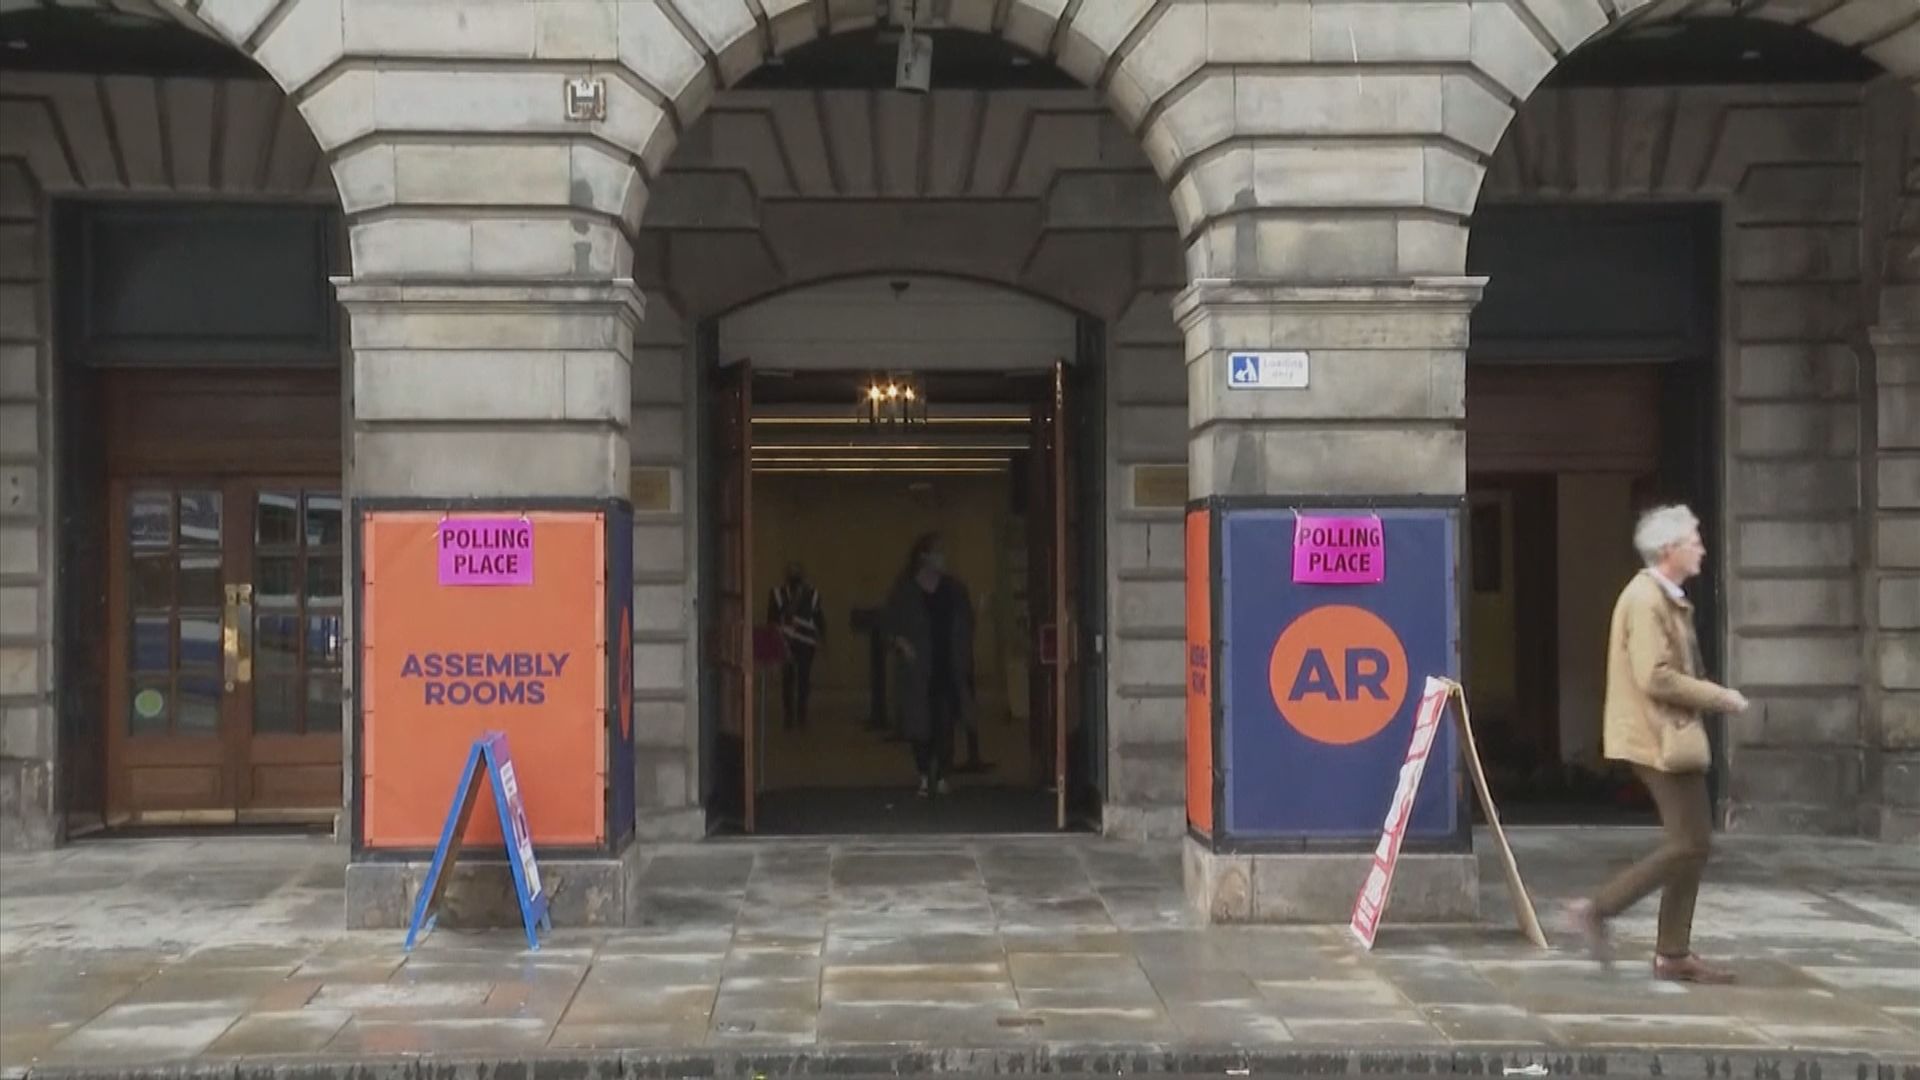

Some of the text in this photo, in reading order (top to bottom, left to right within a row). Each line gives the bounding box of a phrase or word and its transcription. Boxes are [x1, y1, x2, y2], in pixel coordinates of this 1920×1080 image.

[442, 529, 530, 549] POLLING
[1300, 528, 1380, 548] POLLING
[454, 554, 518, 574] PLACE
[1309, 553, 1370, 572] PLACE
[400, 653, 570, 677] ASSEMBLY
[1288, 648, 1390, 700] AR
[424, 681, 545, 705] ROOMS
